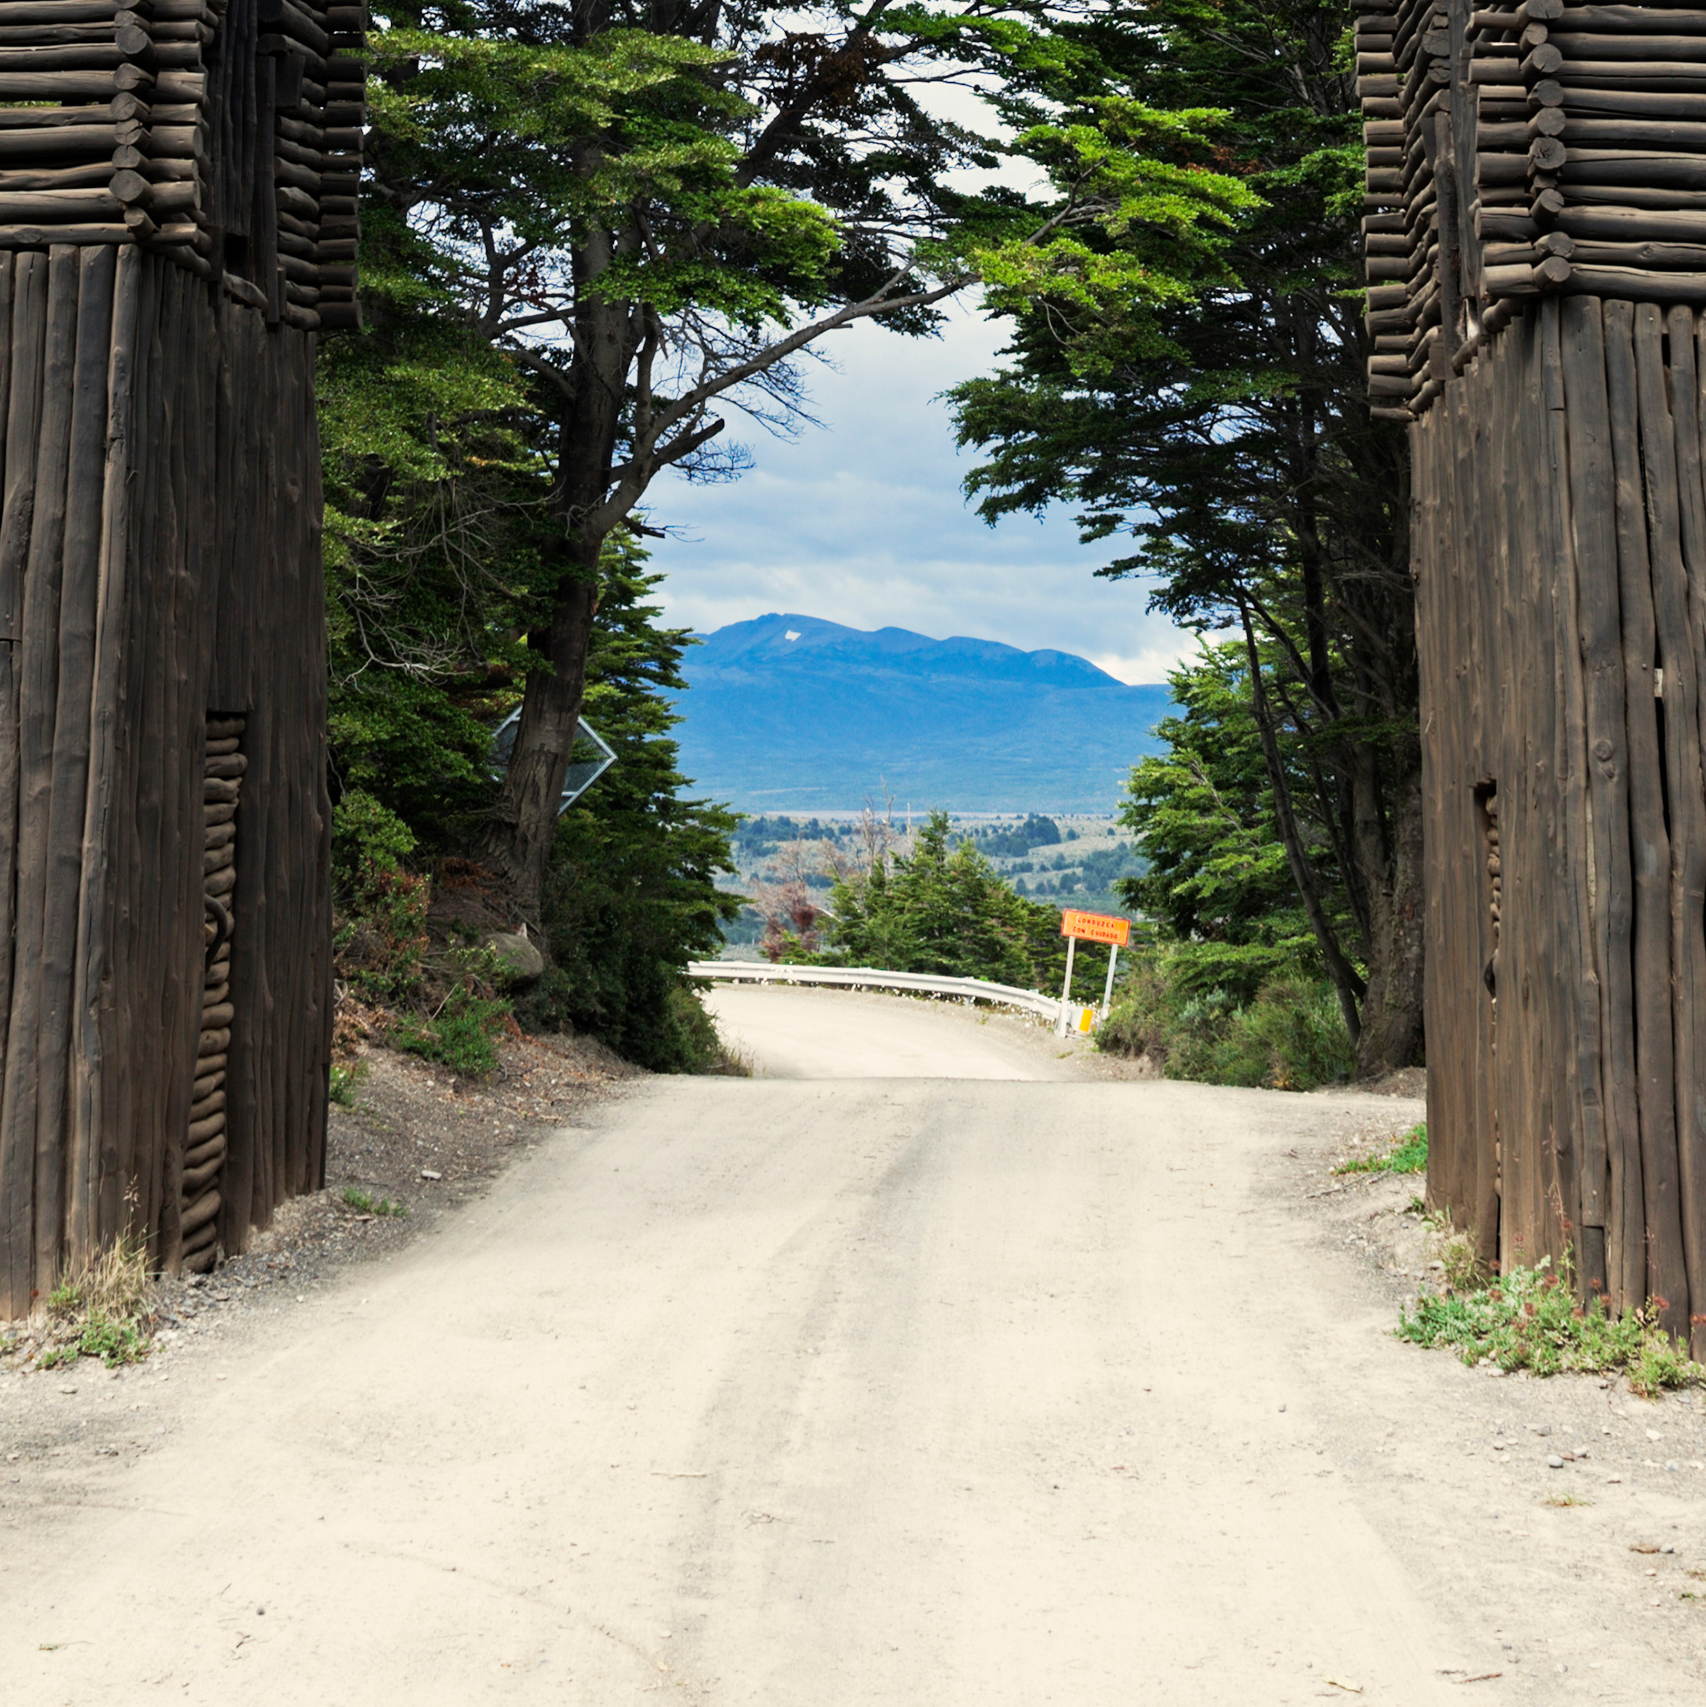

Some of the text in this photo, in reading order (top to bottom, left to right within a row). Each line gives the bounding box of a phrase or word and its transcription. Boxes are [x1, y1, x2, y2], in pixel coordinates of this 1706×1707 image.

[1077, 917, 1115, 928] CONDUZCA
[1072, 926, 1119, 940] CON CUIDADO
